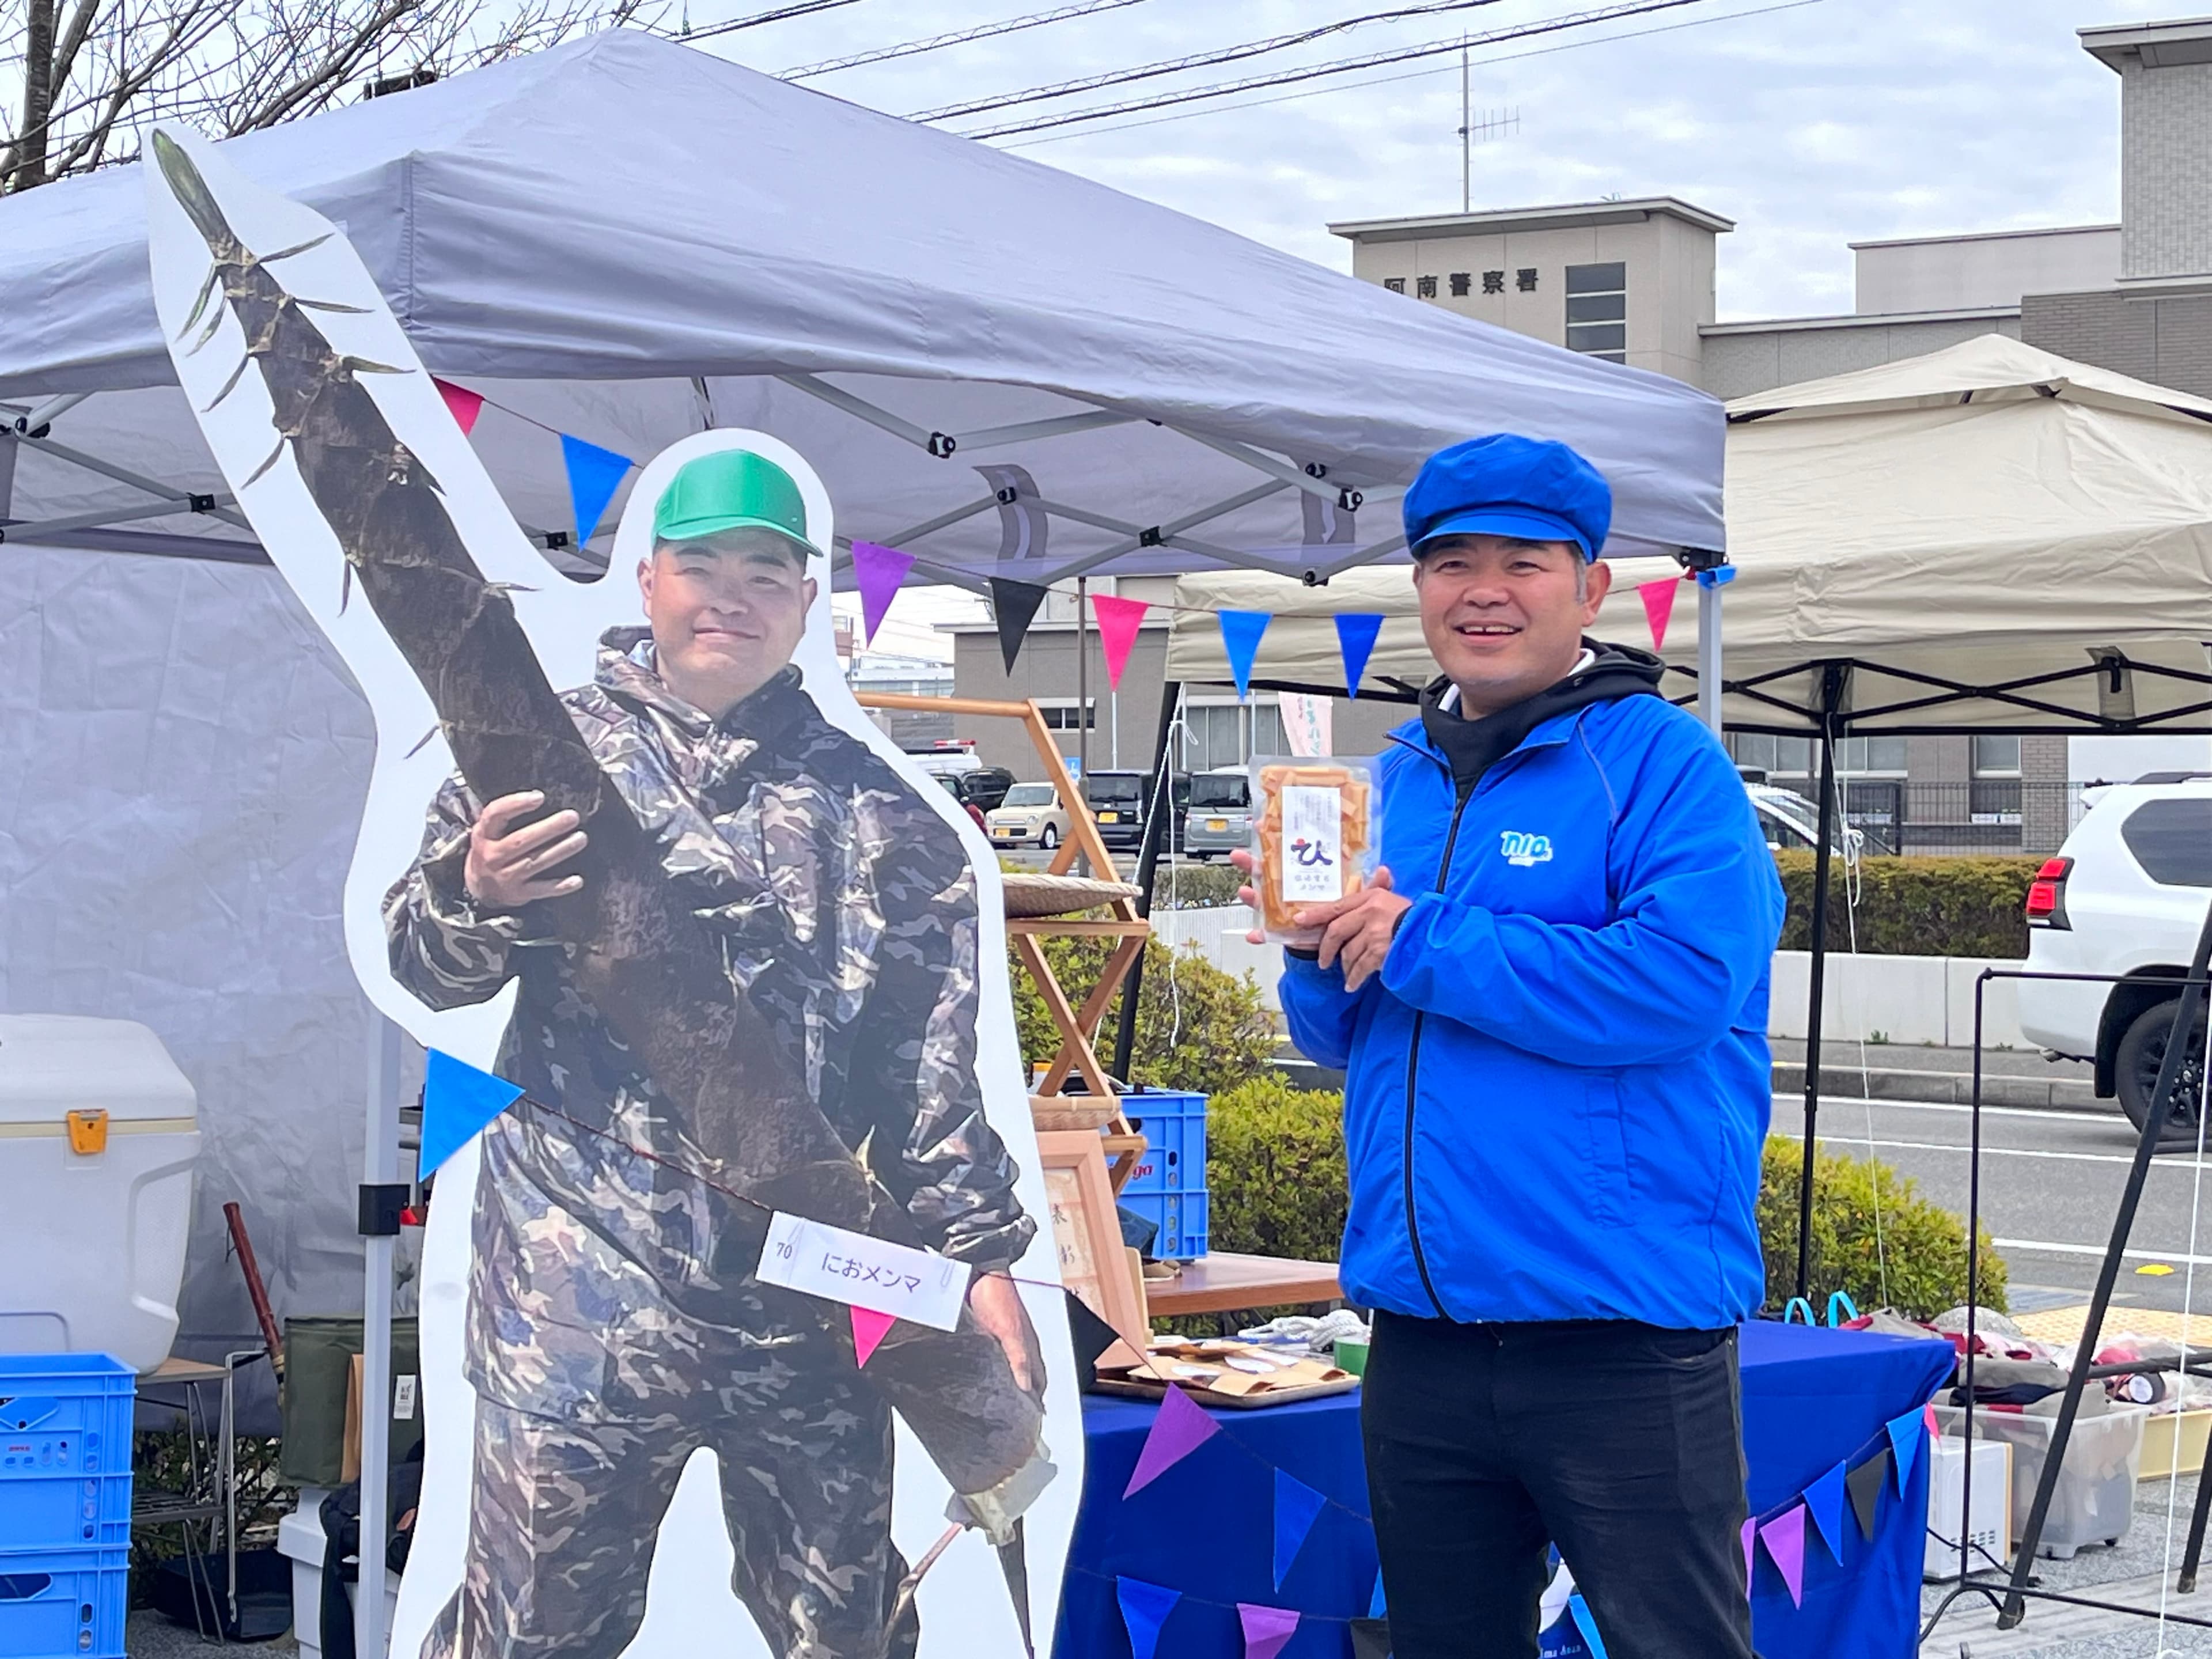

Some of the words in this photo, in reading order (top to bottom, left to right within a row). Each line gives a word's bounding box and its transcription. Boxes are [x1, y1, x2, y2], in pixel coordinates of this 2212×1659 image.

[1291, 839, 1333, 865] ひ
[777, 1243, 793, 1259] 70
[821, 1252, 921, 1293] におメンマ
